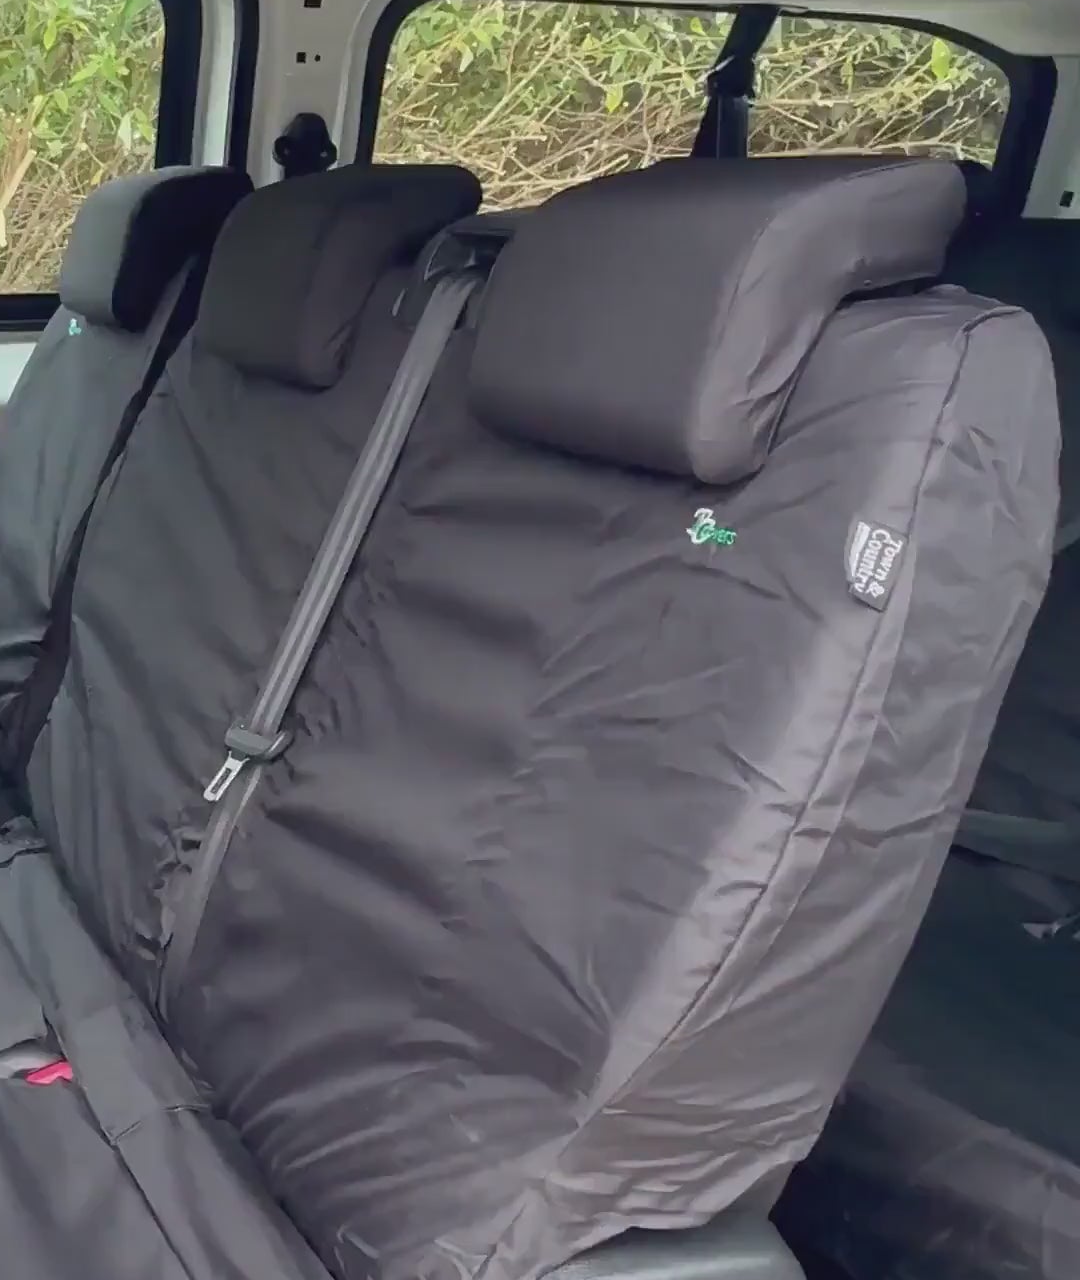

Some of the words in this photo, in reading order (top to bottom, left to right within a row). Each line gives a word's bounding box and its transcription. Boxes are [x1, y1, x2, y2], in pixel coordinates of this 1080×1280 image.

[854, 529, 891, 593] Country
[874, 539, 903, 581] Town
[866, 580, 885, 598] &
